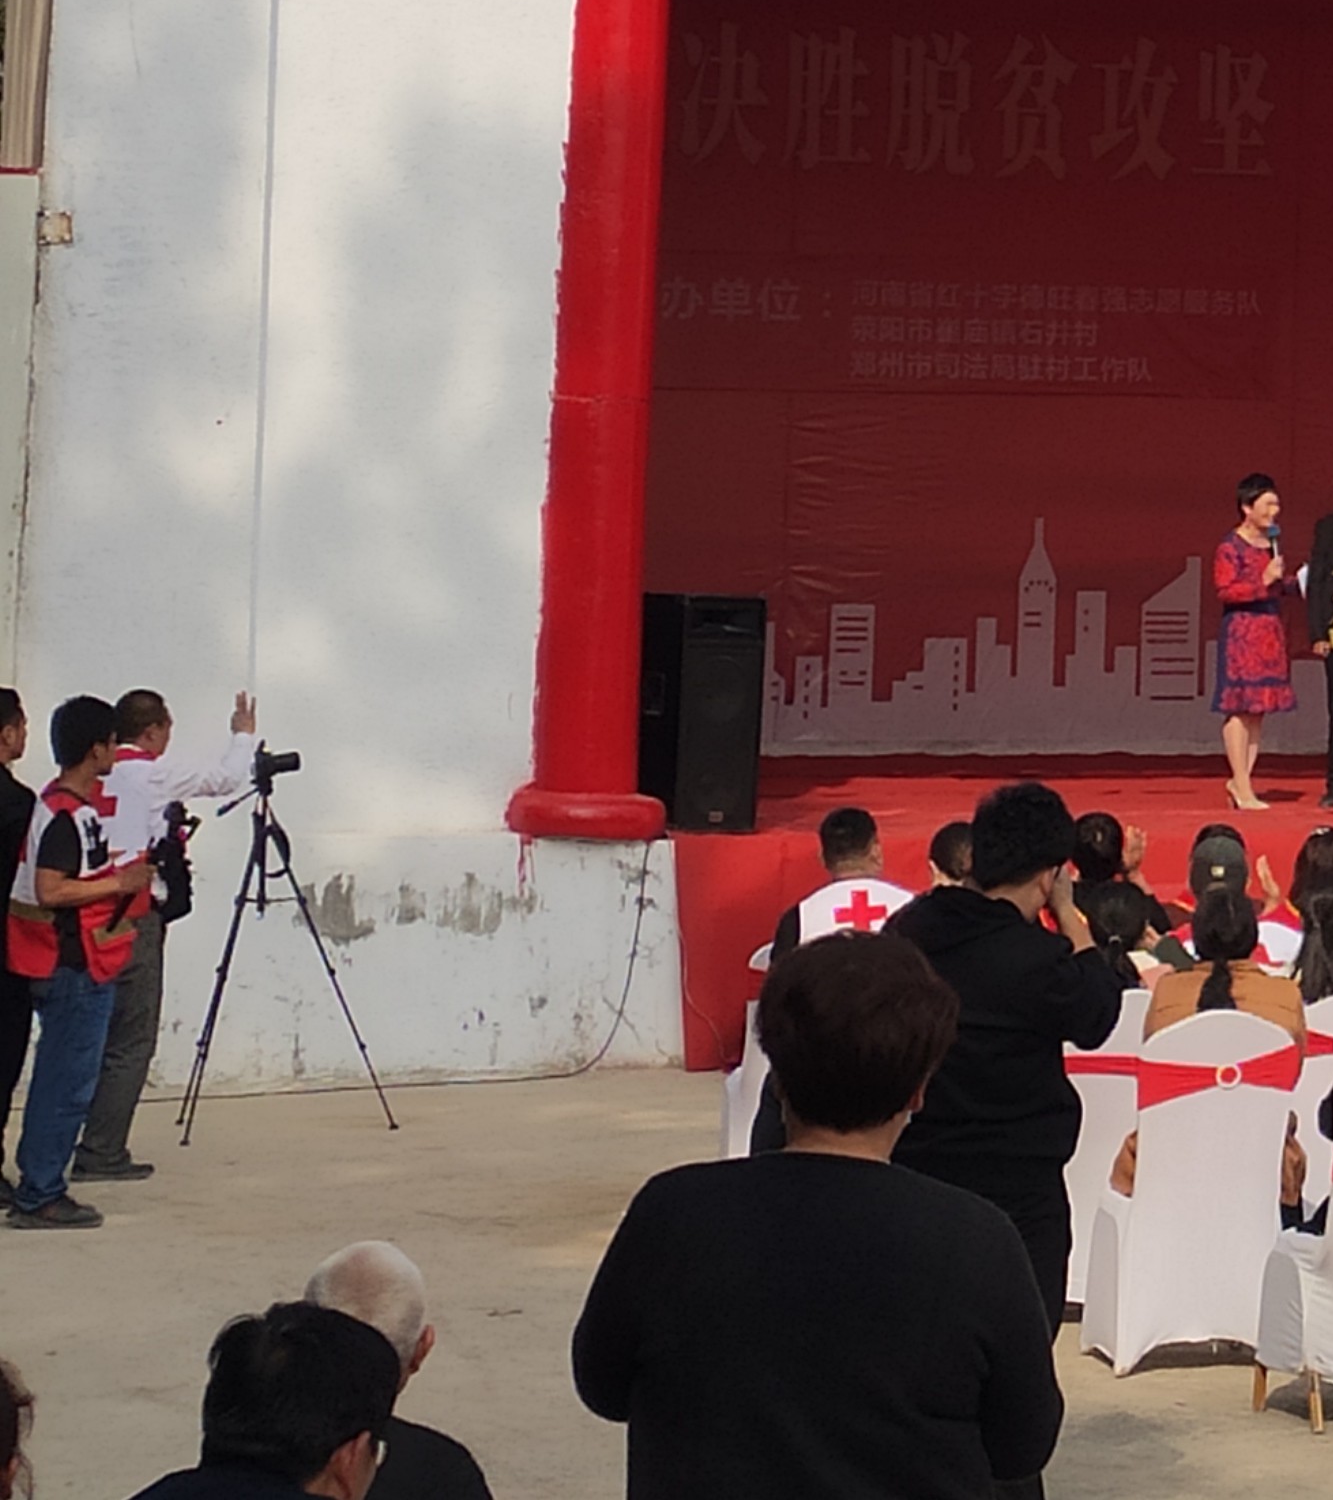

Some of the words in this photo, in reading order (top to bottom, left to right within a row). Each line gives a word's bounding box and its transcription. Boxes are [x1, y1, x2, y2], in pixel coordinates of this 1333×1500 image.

[679, 20, 1276, 183] 决胜脱贫攻坚
[850, 314, 1098, 347] 荥阳市崔庙镇石井村
[849, 350, 1153, 383] 郑州市司法局驻村工作队
